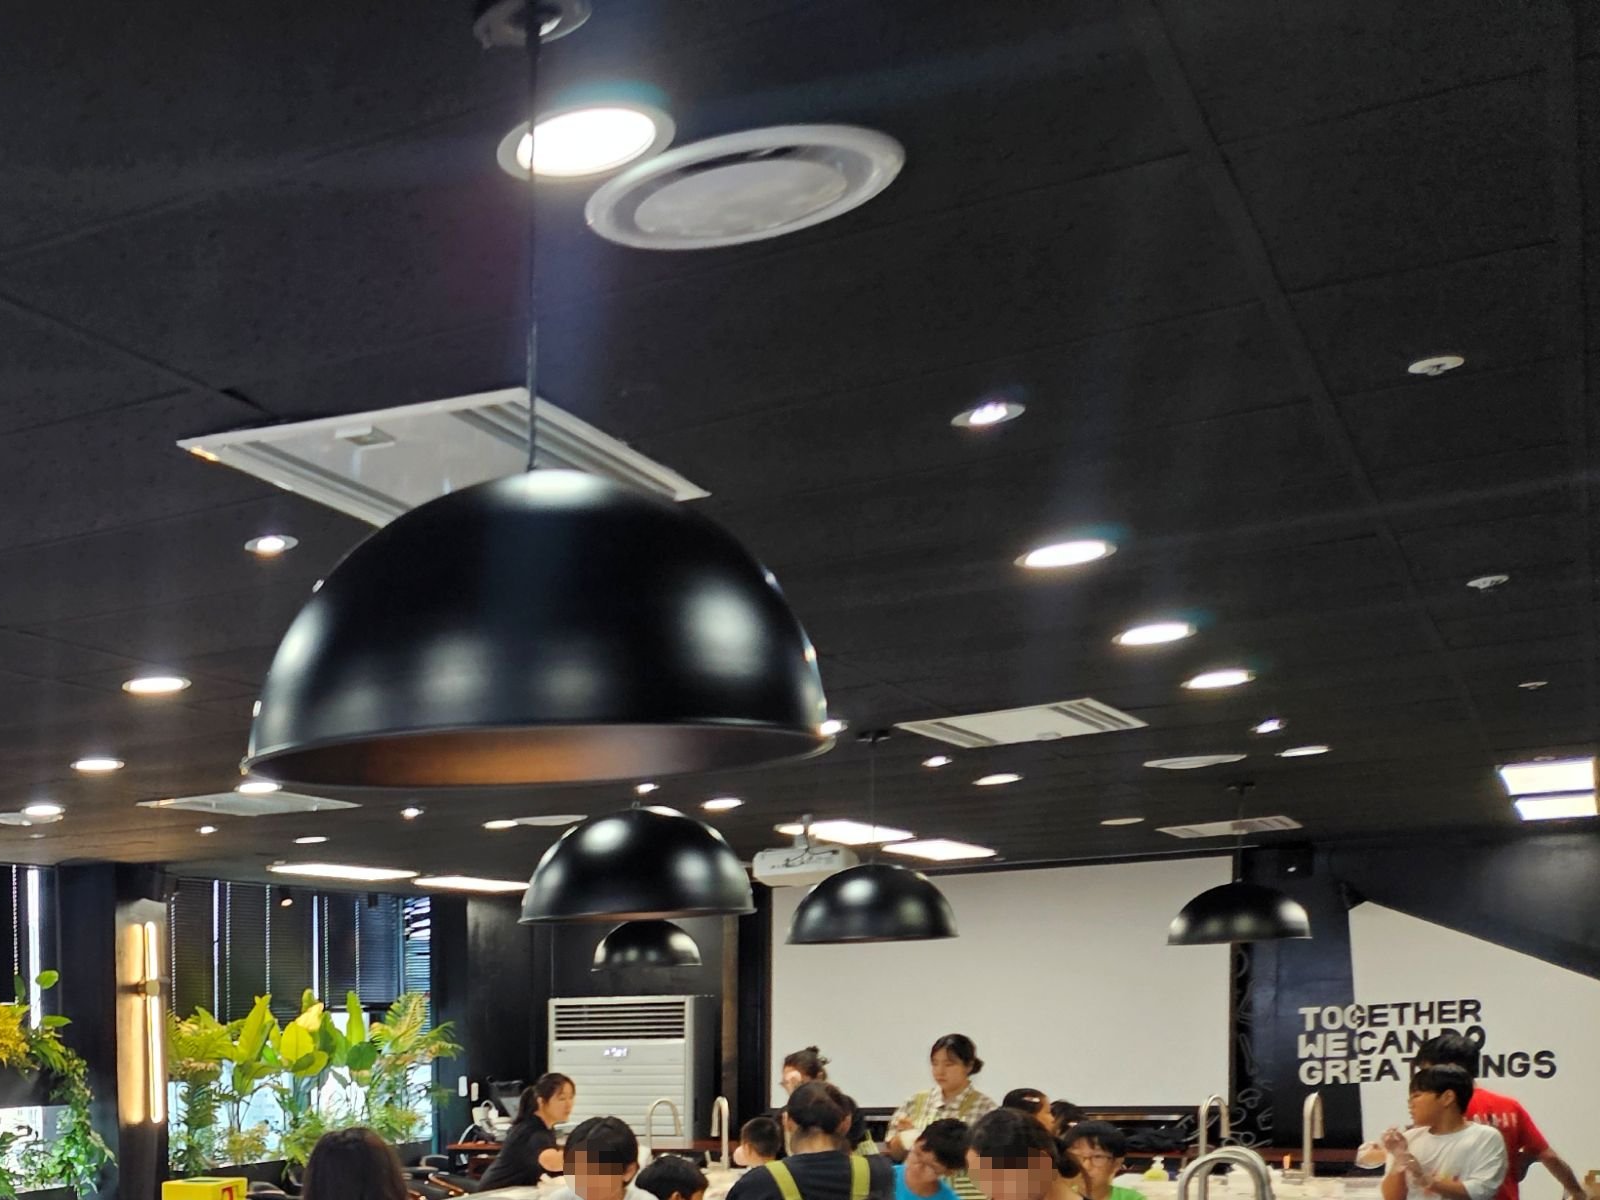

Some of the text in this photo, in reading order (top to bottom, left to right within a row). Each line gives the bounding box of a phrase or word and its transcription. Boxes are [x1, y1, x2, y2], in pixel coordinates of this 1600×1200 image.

[1298, 999, 1482, 1031] TOGETHER
[1297, 1032, 1348, 1059] WE
[1354, 1029, 1428, 1056] CAN
[1471, 1050, 1557, 1079] INGS
